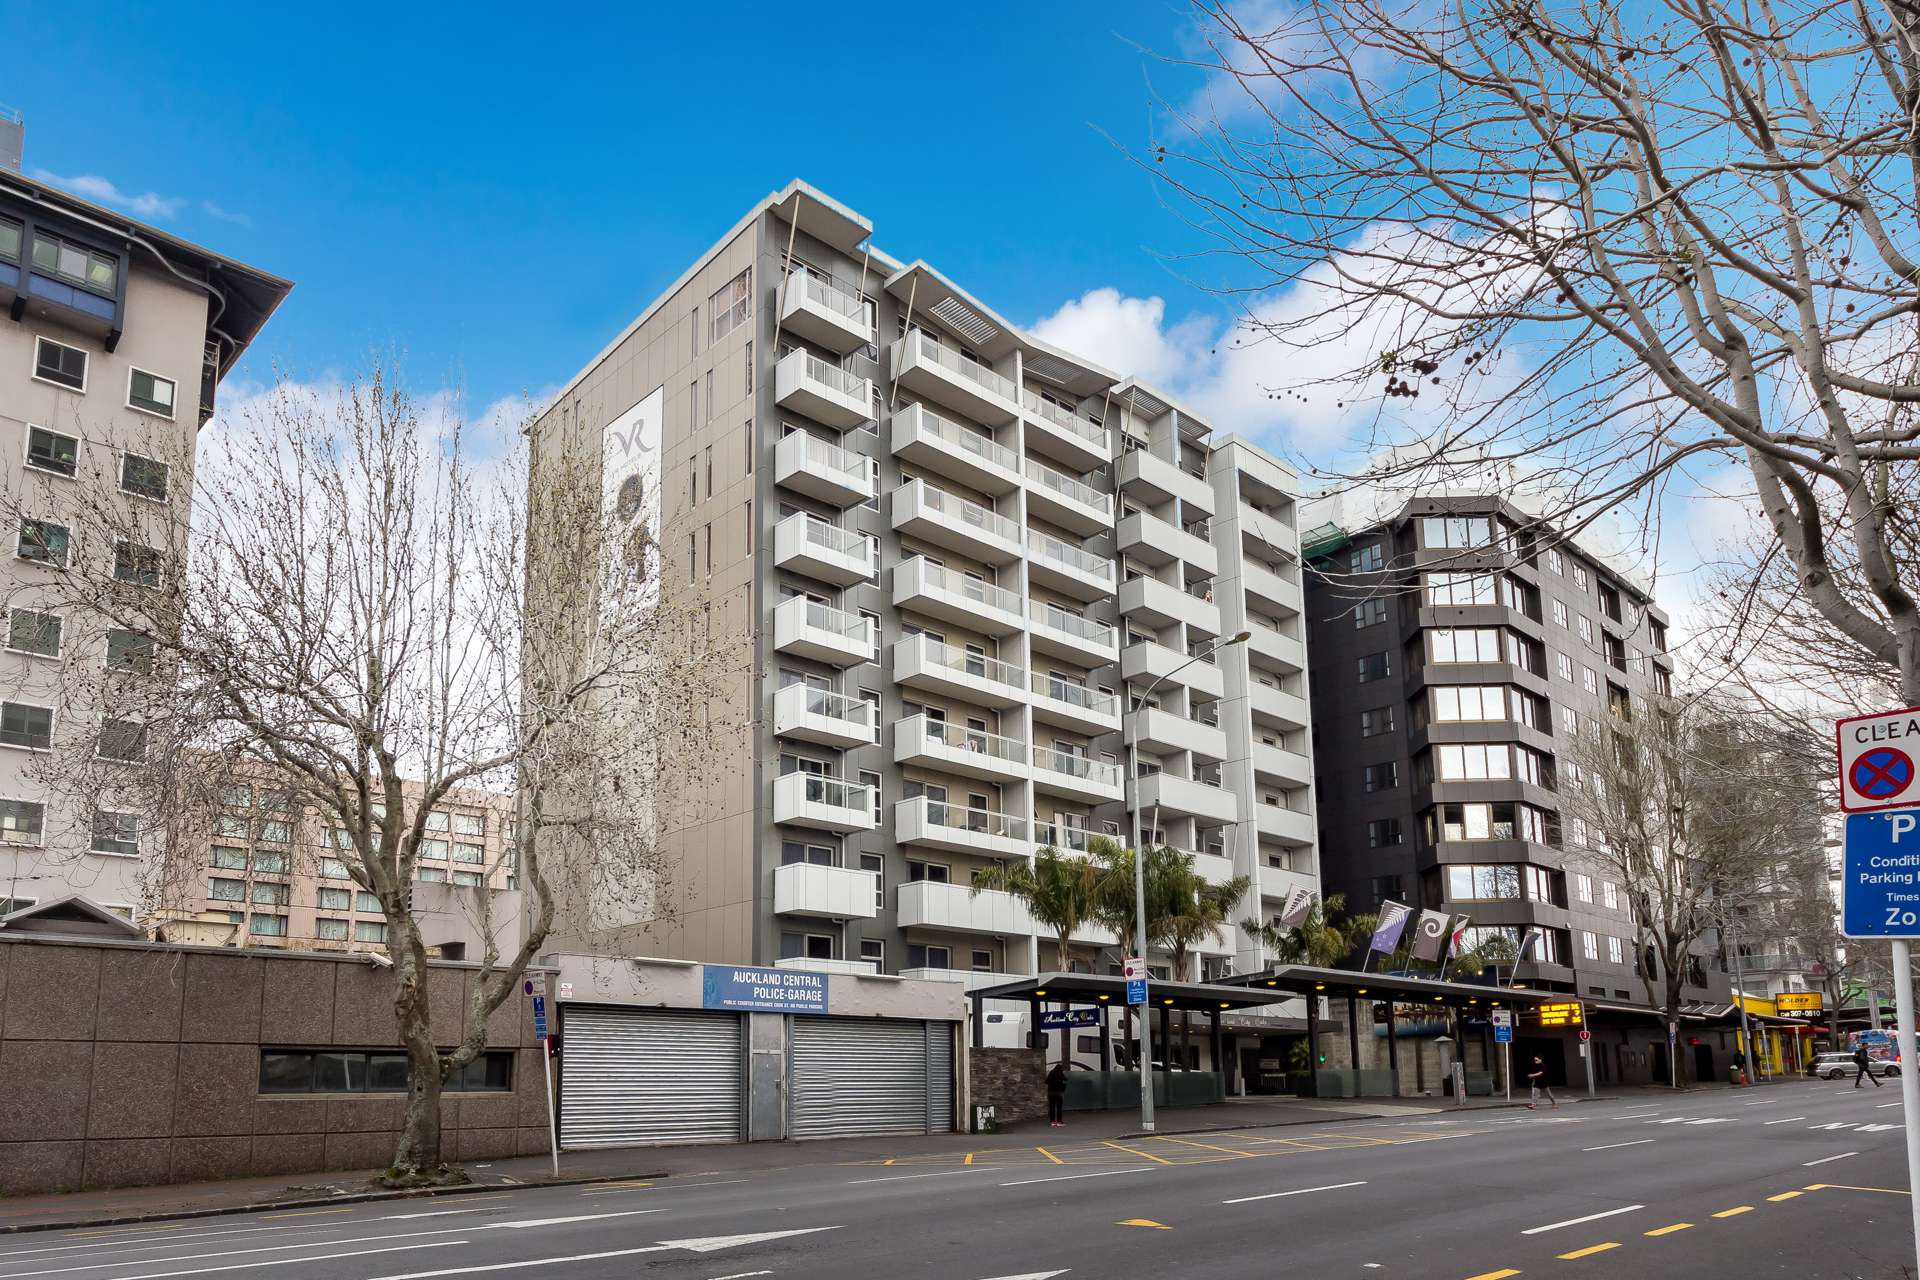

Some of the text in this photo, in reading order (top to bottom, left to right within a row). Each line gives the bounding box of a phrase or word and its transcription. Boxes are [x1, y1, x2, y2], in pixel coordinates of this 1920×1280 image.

[1860, 872, 1913, 885] Parking
[1886, 892, 1920, 902] Times
[733, 971, 822, 987] AUCKLAND CENTRAL
[753, 987, 822, 1001] POLICE-GARAGE
